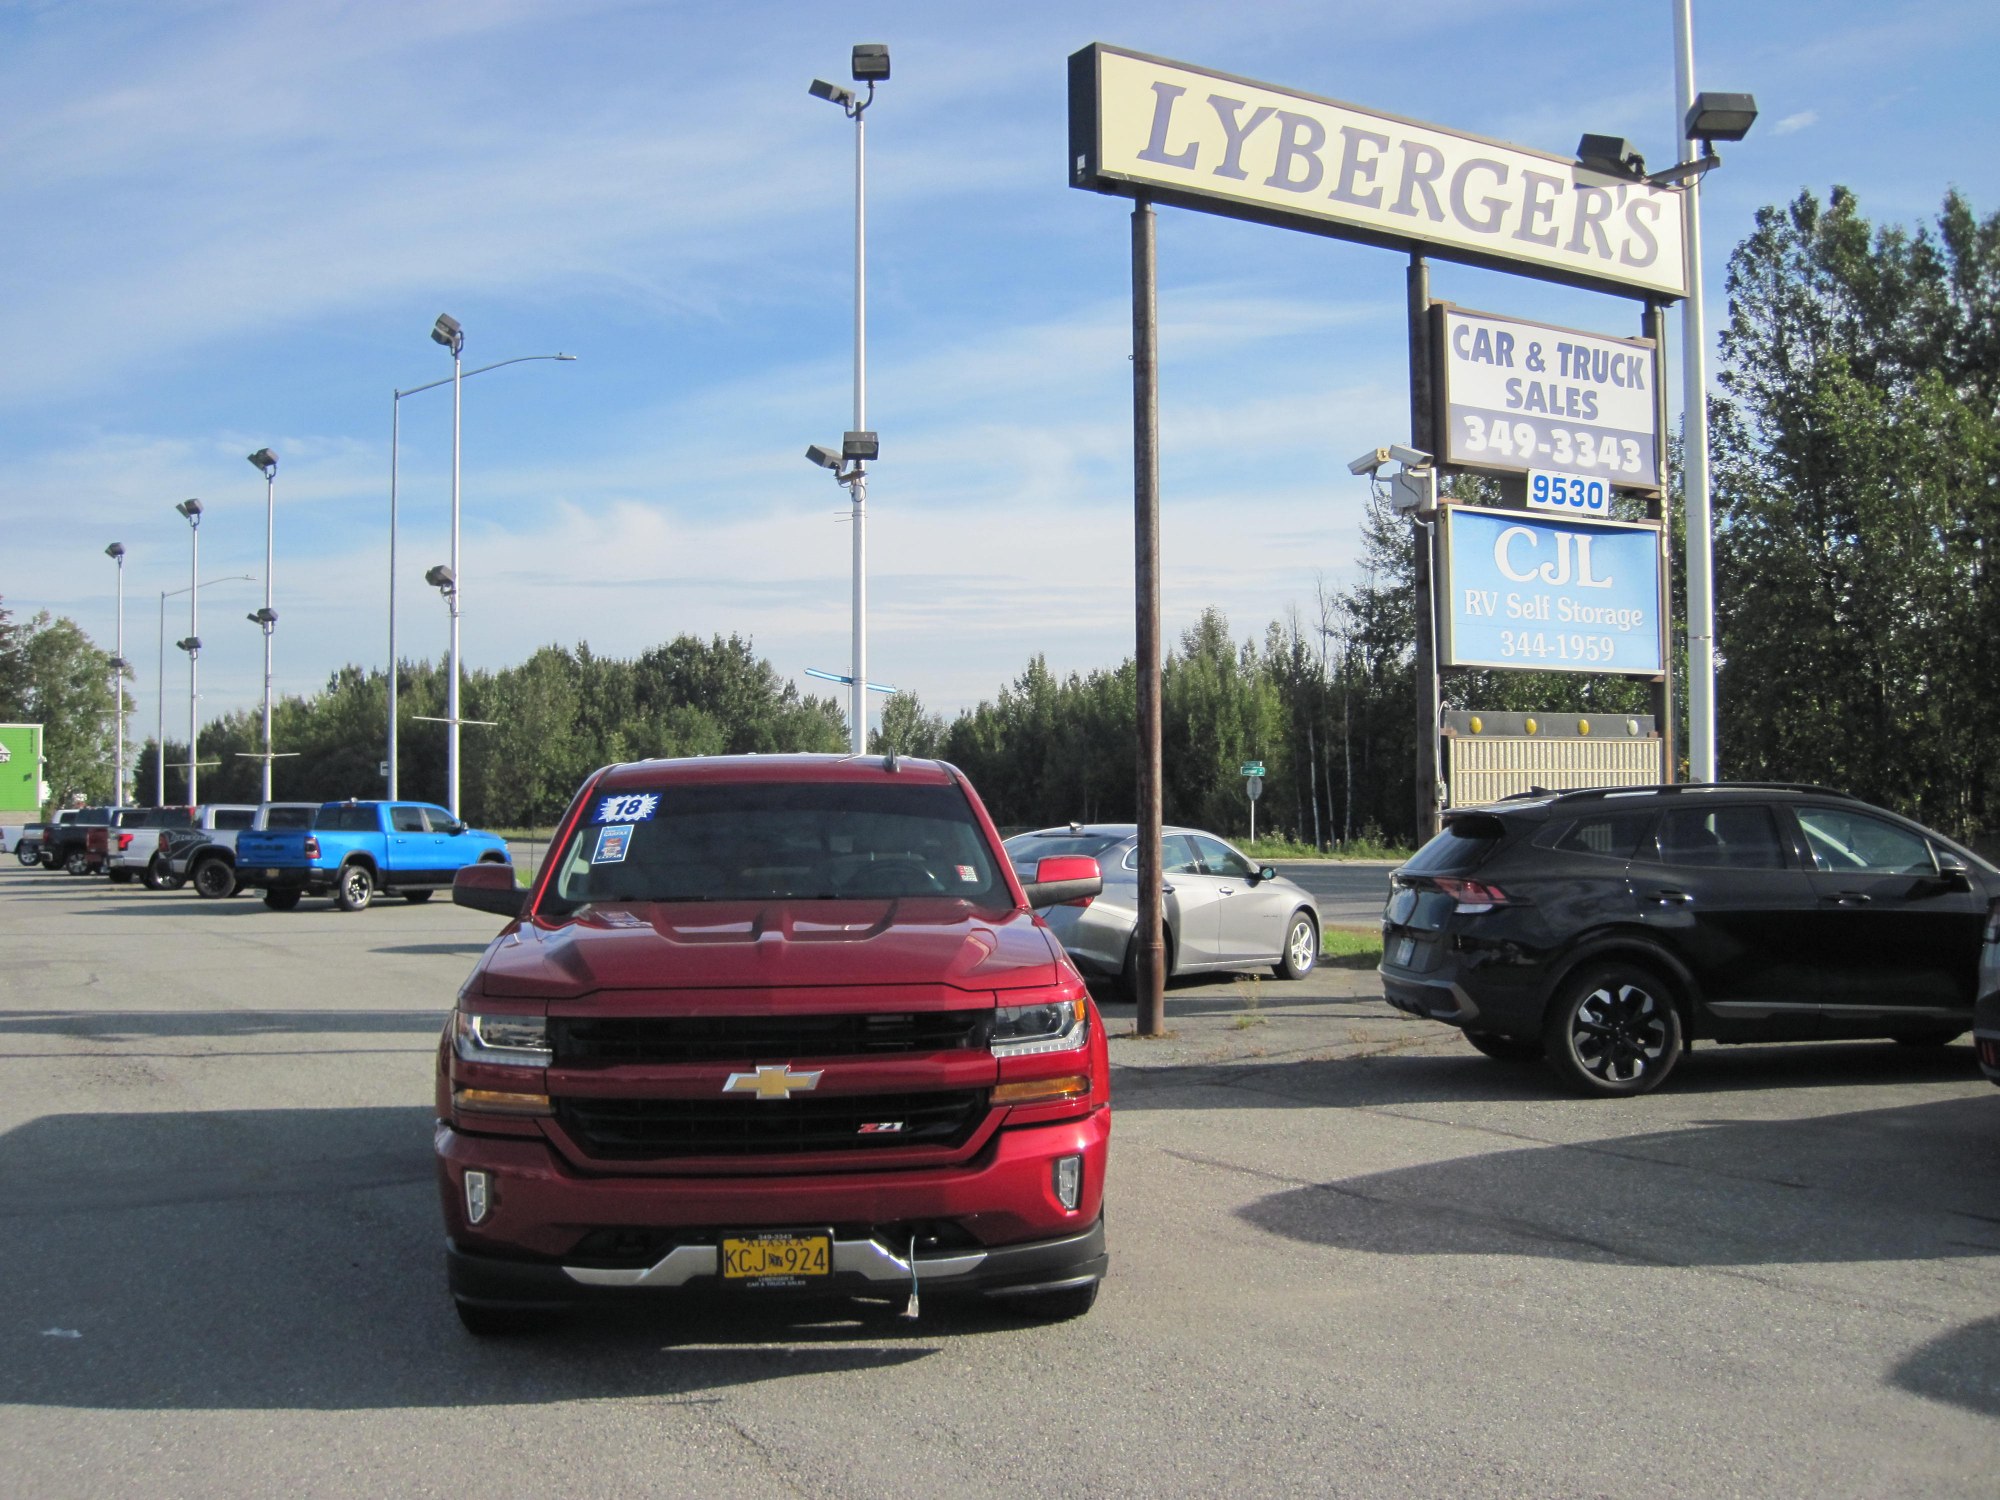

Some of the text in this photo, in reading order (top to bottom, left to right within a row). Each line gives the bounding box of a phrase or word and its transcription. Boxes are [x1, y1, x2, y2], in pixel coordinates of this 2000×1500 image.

[1136, 81, 1661, 268] LYBERGER'S
[1453, 324, 1645, 390] CAR & TRUCK
[1505, 377, 1599, 420] SALES
[1463, 415, 1642, 473] 349-3343
[1532, 474, 1603, 509] 9530
[1494, 526, 1613, 588] CJL
[1464, 589, 1644, 631] RV Self Storage
[1501, 631, 1615, 662] 344-1959
[614, 799, 643, 816] 18
[724, 1247, 827, 1274] KCJ 924
[747, 1239, 804, 1248] ALASKA
